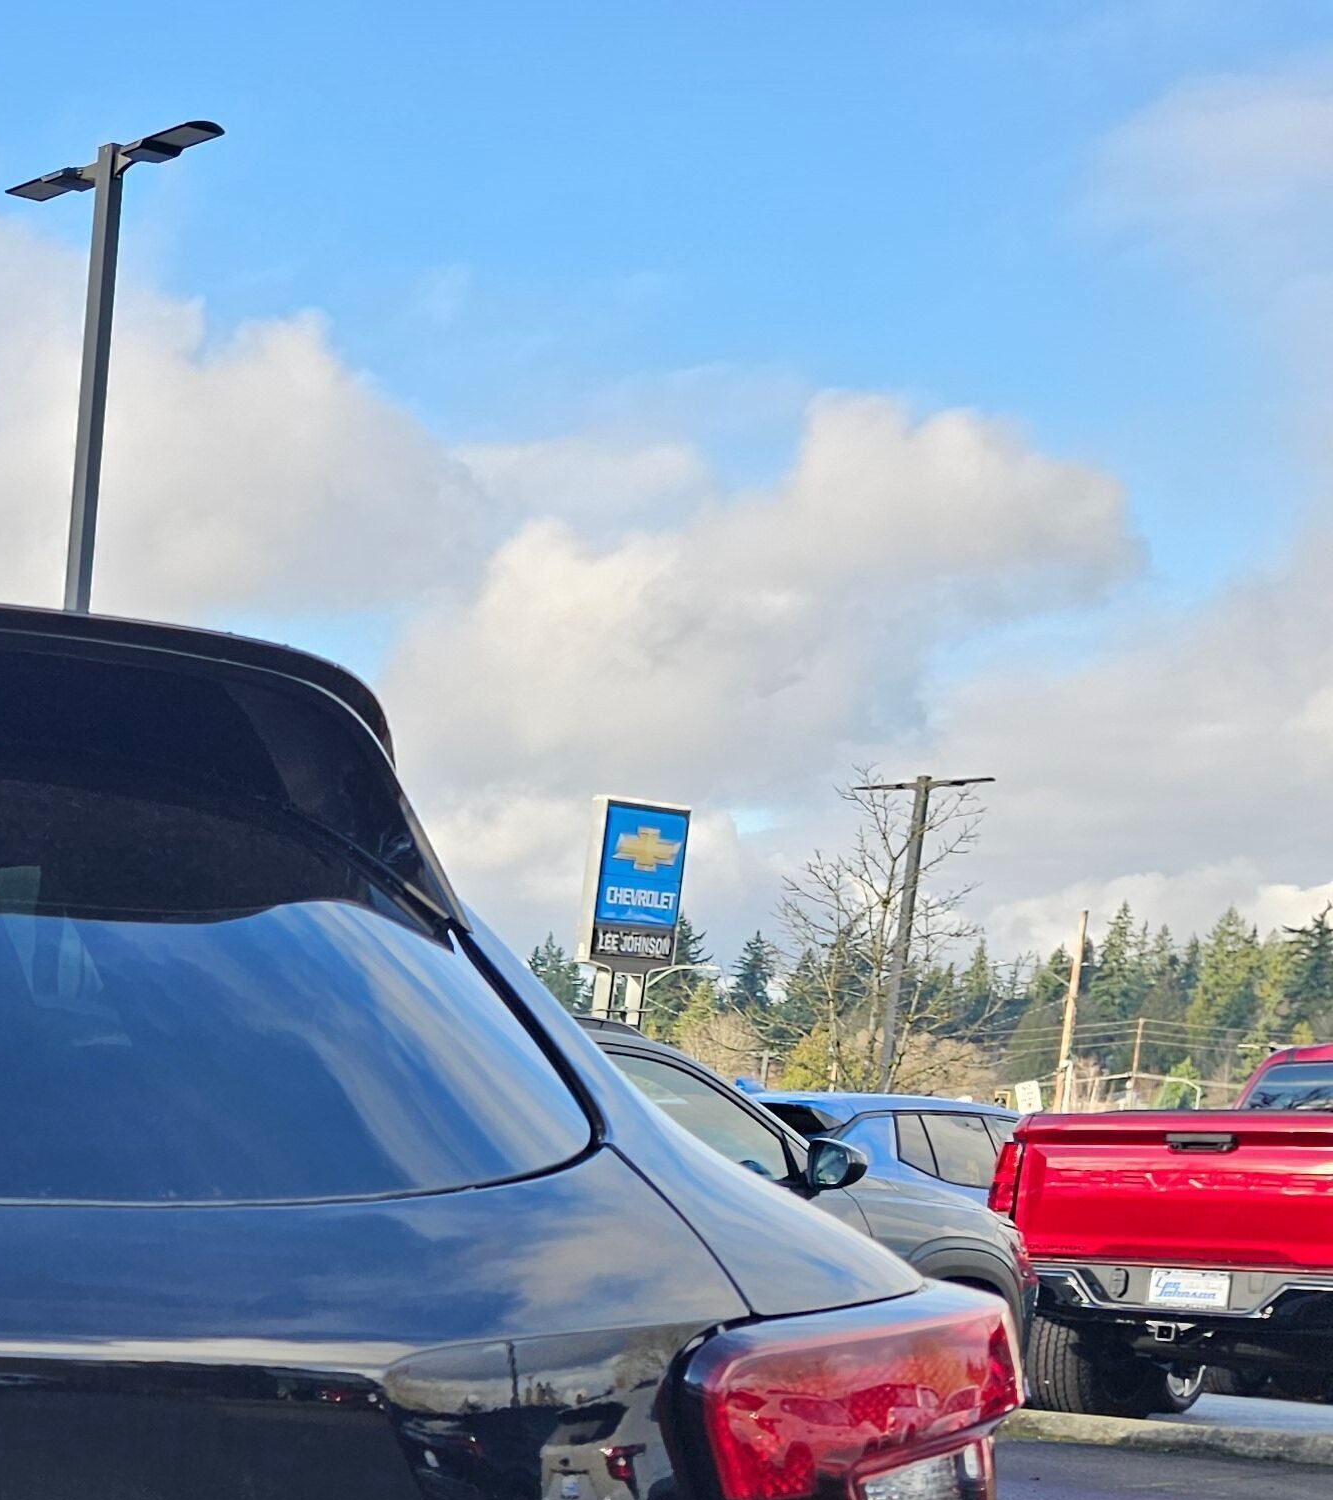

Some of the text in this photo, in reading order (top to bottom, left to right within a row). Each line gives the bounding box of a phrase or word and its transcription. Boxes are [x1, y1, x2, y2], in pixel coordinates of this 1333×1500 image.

[606, 885, 677, 911] CHEVROLET
[598, 929, 671, 955] LEE JOHNSON
[1044, 1169, 1333, 1197] CHEVROLE
